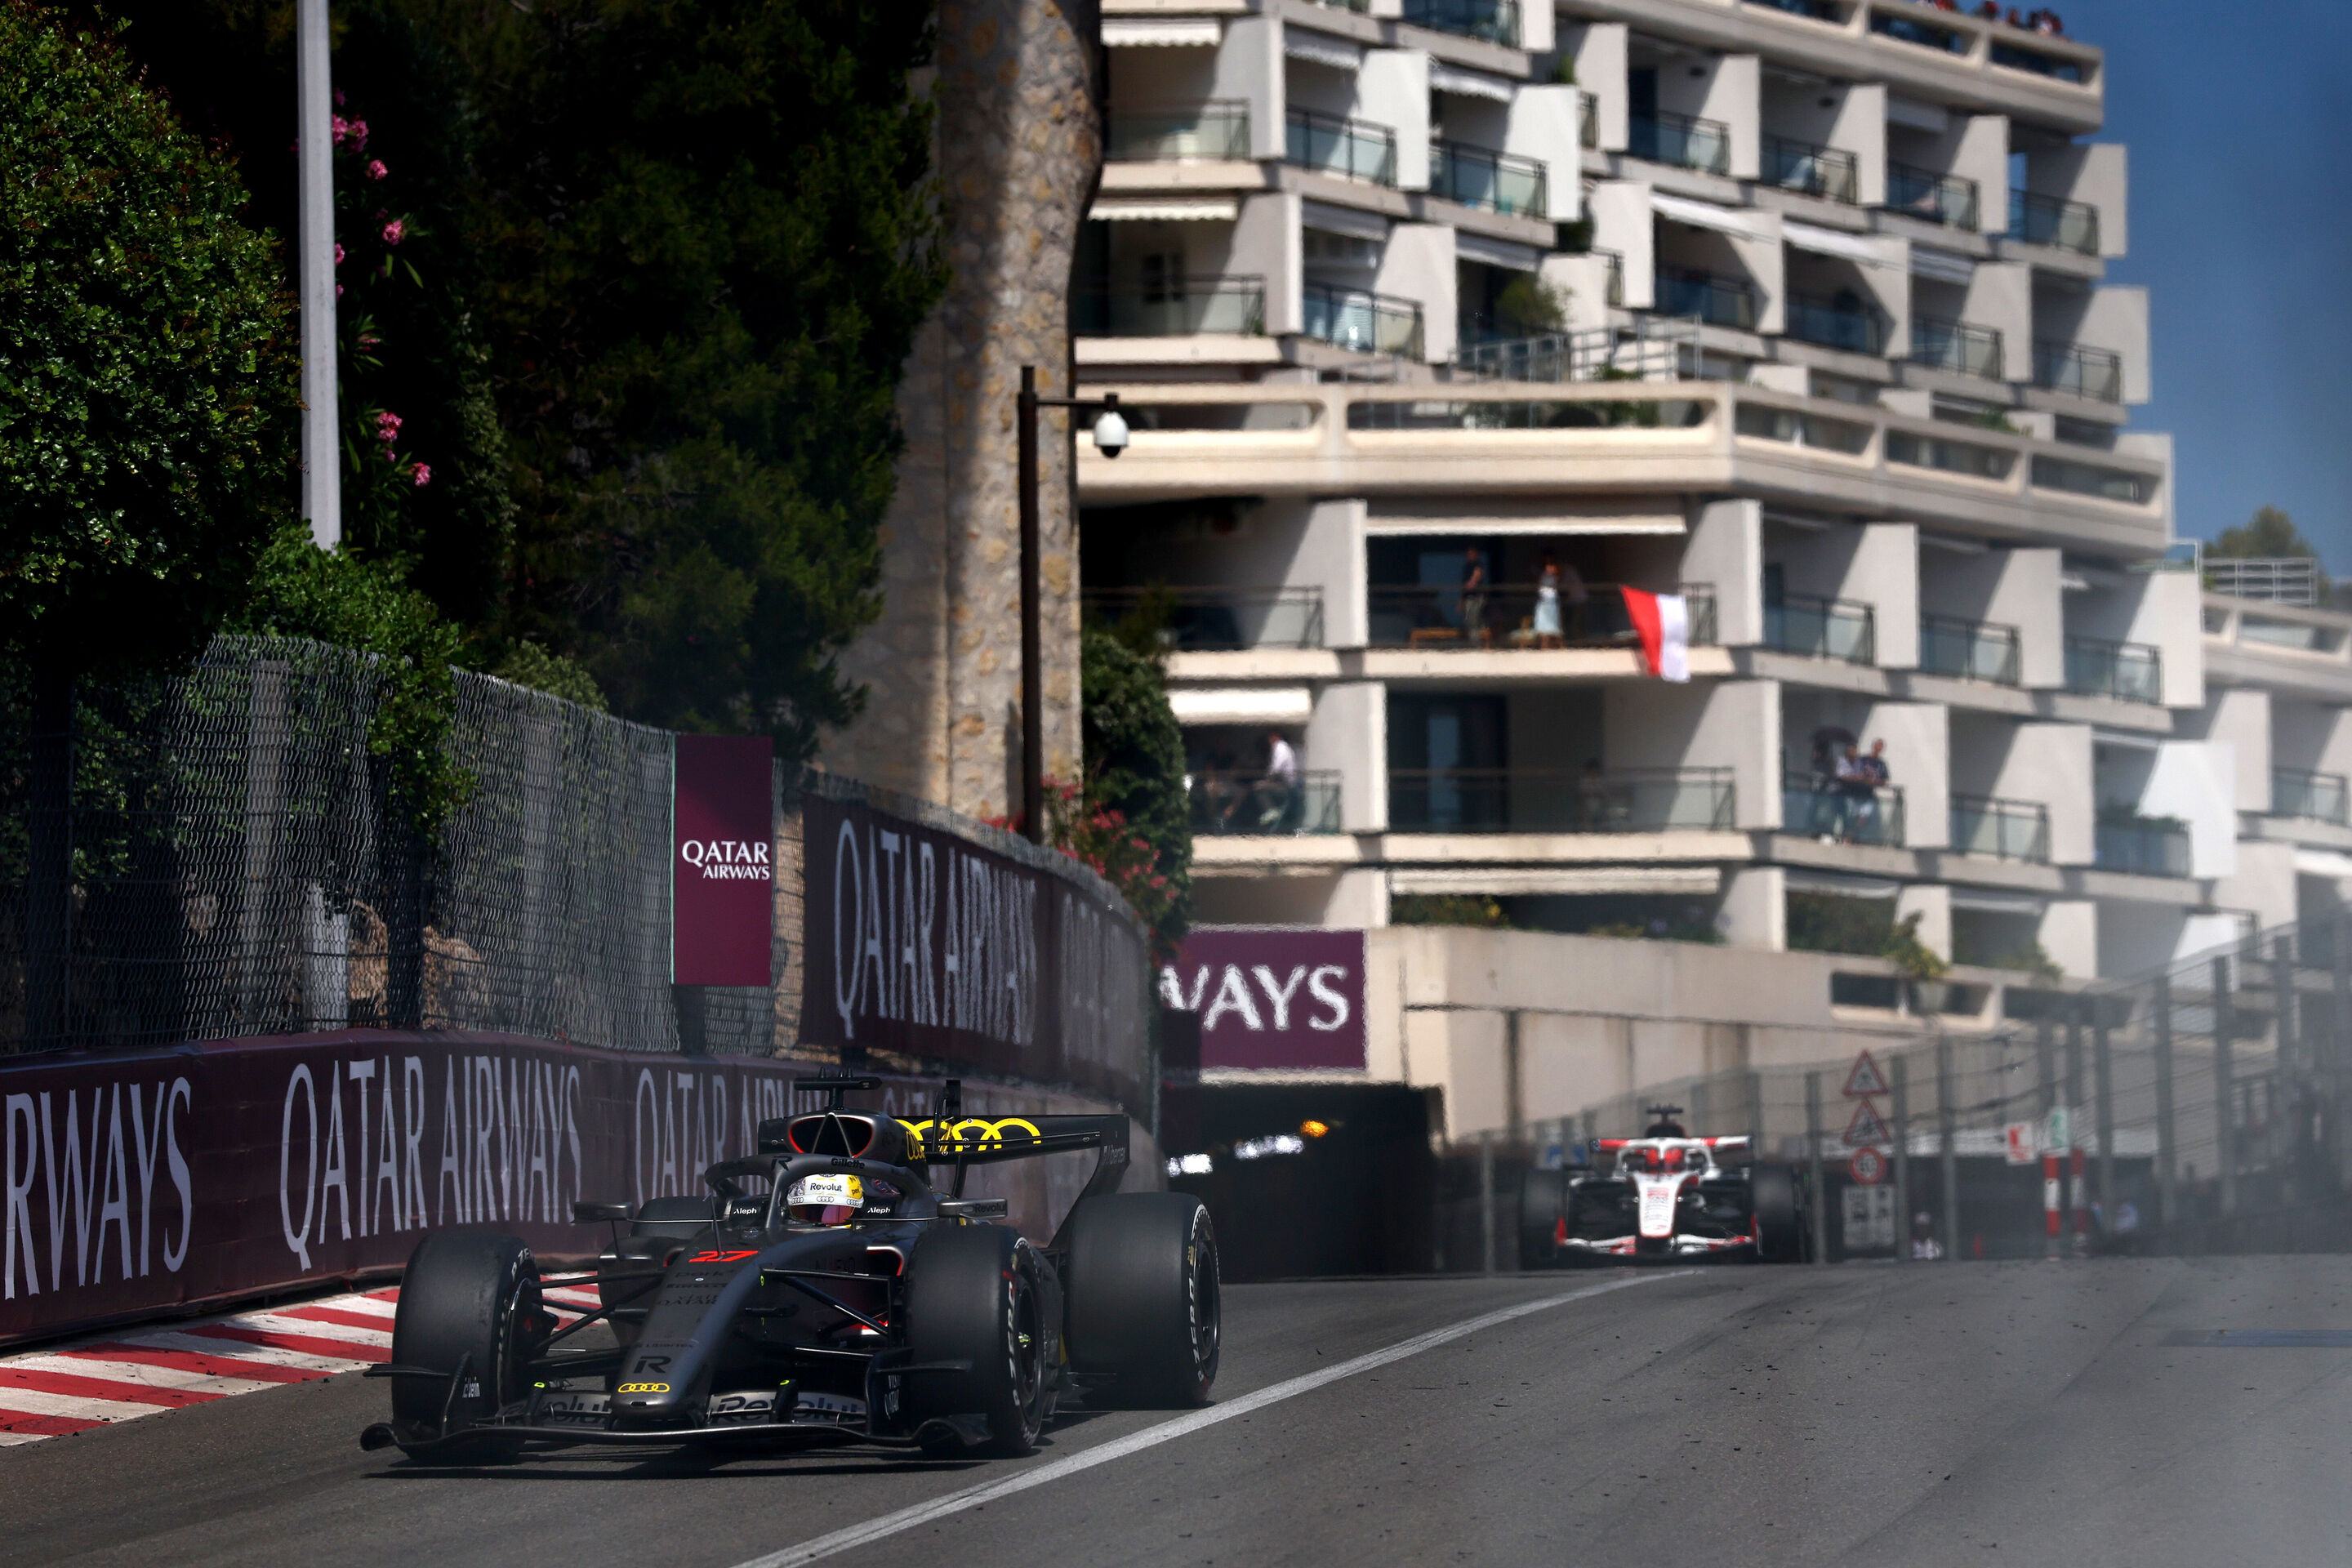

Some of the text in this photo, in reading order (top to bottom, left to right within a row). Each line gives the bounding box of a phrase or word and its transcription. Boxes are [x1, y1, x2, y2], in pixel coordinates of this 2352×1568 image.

[682, 840, 769, 867] QATAR
[703, 864, 770, 880] AIRWAYS
[835, 818, 938, 1040] QATAR
[280, 1056, 427, 1271] QATAR
[439, 1054, 582, 1225] AIRWAYS
[831, 1157, 866, 1169] Gillette
[4, 1077, 192, 1299] RWAYS
[810, 1183, 843, 1192] Revolut
[733, 1206, 758, 1216] Aleph
[867, 1206, 891, 1214] Aleph
[688, 1250, 760, 1263] 27
[715, 1392, 863, 1423] Reolut
